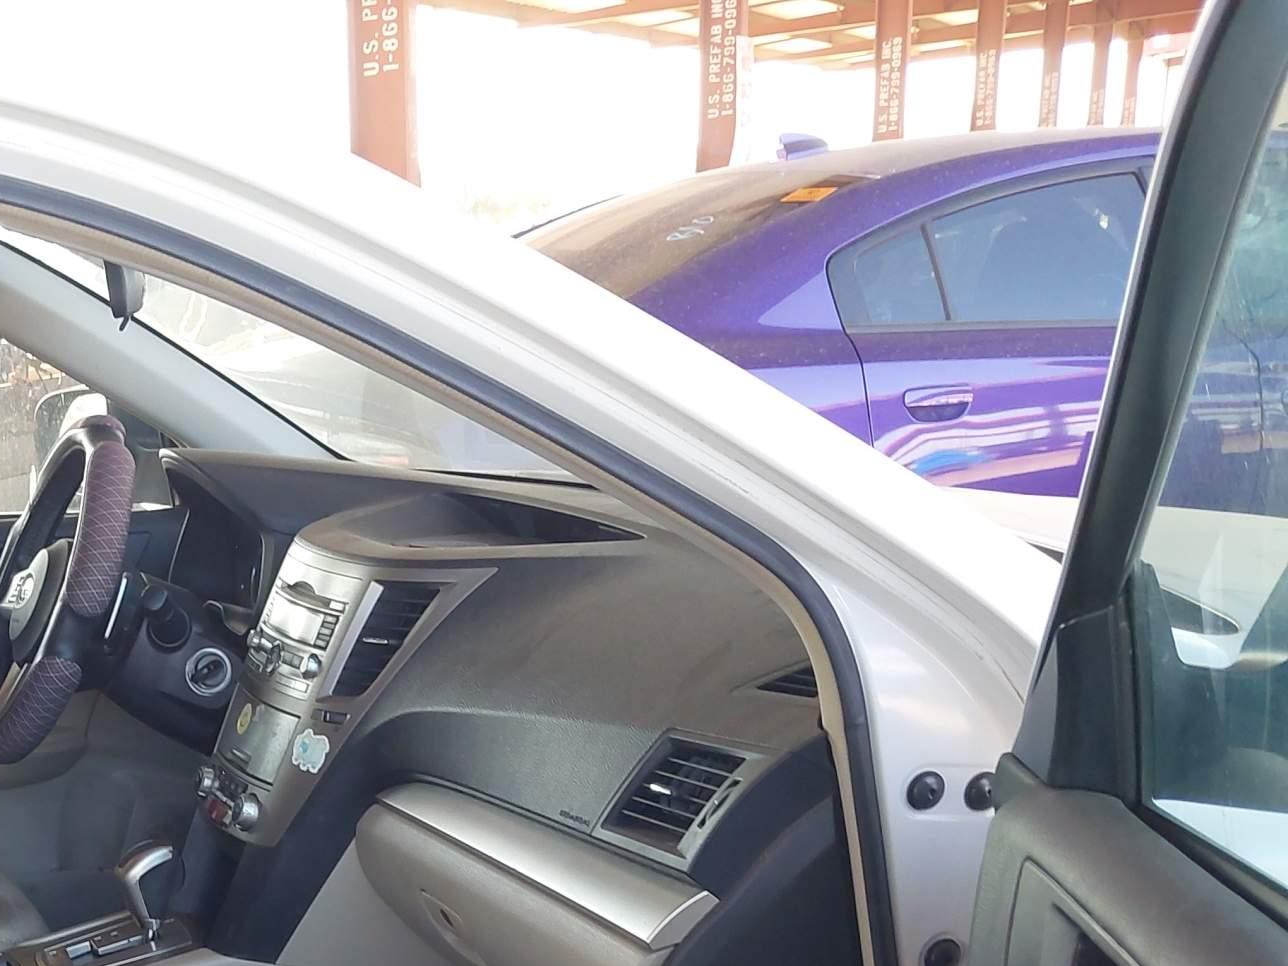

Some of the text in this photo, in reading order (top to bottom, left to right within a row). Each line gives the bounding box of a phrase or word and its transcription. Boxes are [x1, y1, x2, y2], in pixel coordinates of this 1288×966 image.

[363, 33, 380, 77] U.S.
[709, 25, 723, 83] PREFAB
[707, 88, 720, 119] U.S.
[880, 63, 890, 107] PREFAB
